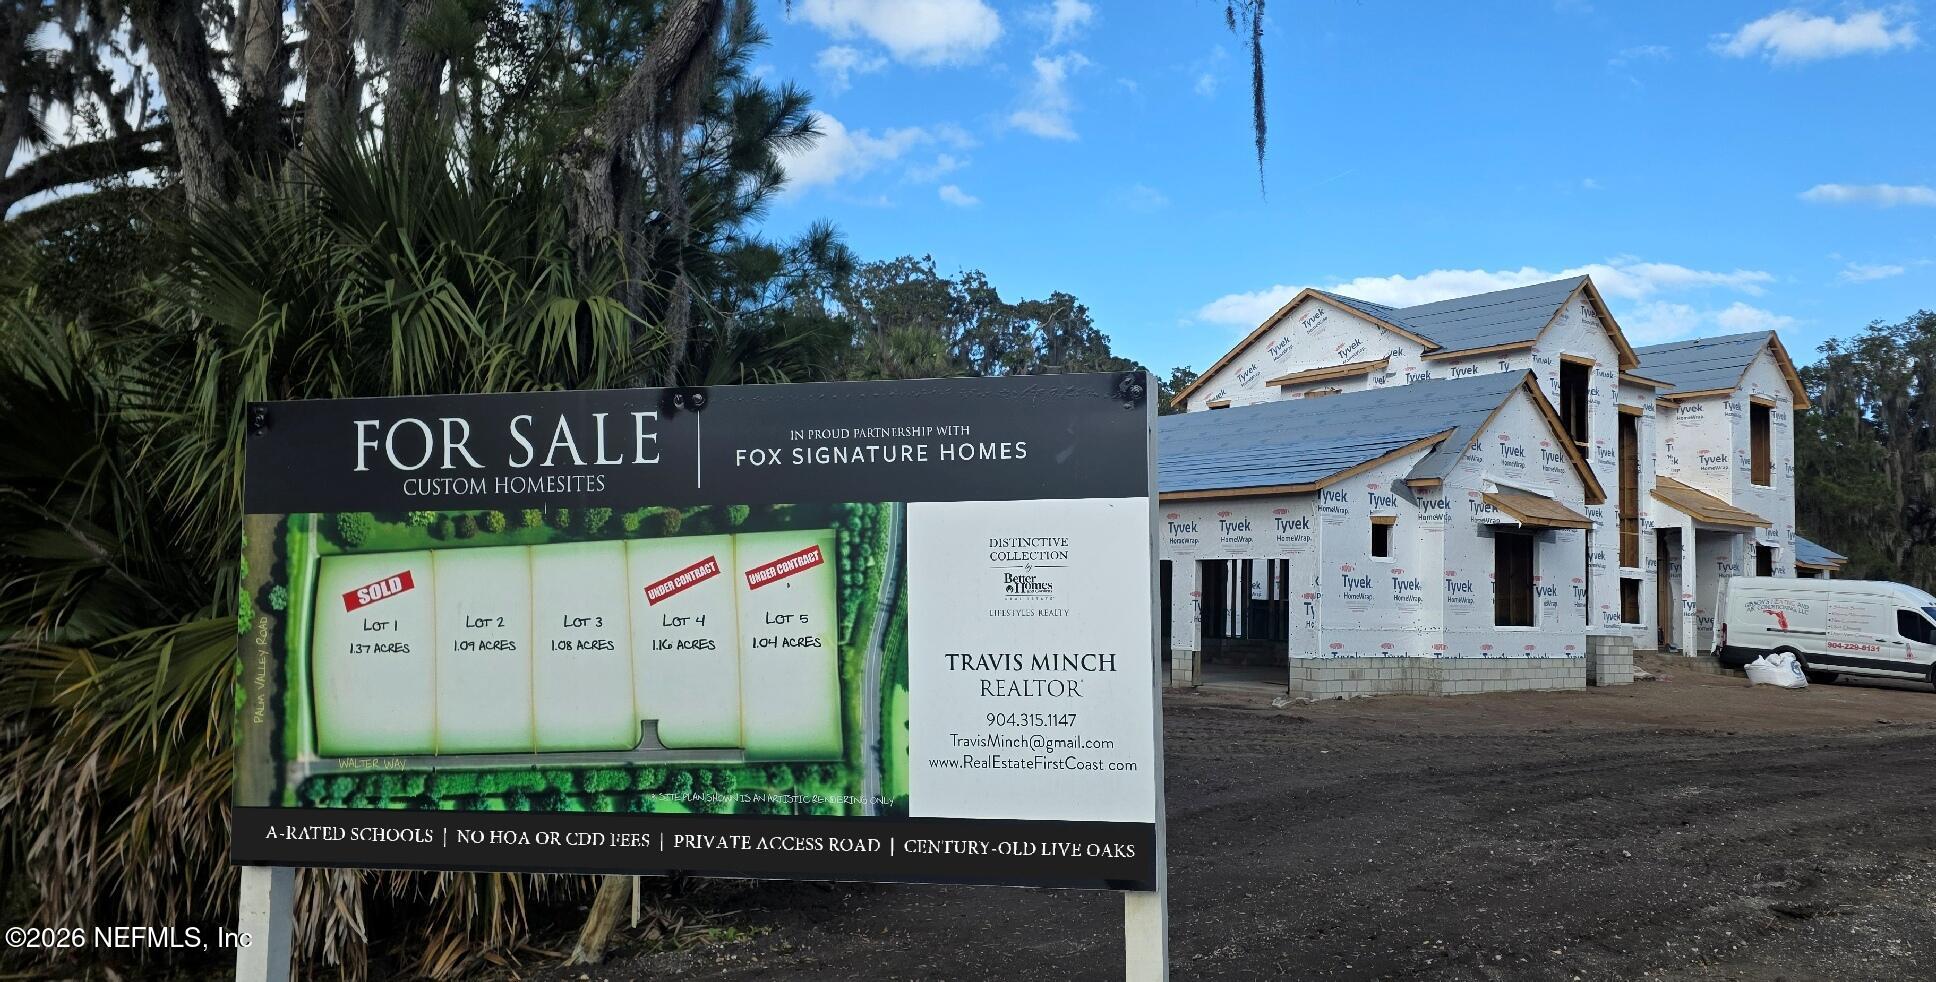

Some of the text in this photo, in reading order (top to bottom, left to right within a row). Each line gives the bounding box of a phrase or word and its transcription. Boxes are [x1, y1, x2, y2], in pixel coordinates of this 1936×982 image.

[1302, 308, 1325, 329] Tyvek
[1581, 306, 1598, 318] Tyve
[1268, 336, 1290, 357] Tyvek
[1338, 338, 1361, 359] Tyvek
[1237, 363, 1258, 383] Tyvek
[1406, 370, 1431, 384] Tyvek
[1451, 364, 1478, 378] Tyvek
[790, 425, 970, 440] IN PROUD PARTNERSHIP WITH
[353, 411, 660, 472] FOR SALE
[736, 441, 1027, 467] FOX SIGNATURE HOMES
[1500, 442, 1525, 458] Tyvek
[1540, 448, 1565, 464] Tyvek
[1597, 446, 1615, 458] Tyvek
[1699, 454, 1728, 466] Tyvek
[403, 474, 605, 496] CUSTOM HOMESITES
[1368, 492, 1397, 509] Tyvek
[1417, 496, 1450, 513] Tyvek
[1585, 507, 1603, 519] Tyvek
[1168, 520, 1198, 536] Tyvek
[1219, 518, 1250, 535] Tyvek
[1274, 516, 1310, 532] Tyvek
[989, 537, 1069, 548] DISTINCTIVE
[989, 550, 1069, 561] COLLECTION
[1589, 551, 1605, 562] yvek
[748, 550, 819, 585] UNDER CONTRACT
[1717, 562, 1739, 572] Tyvek
[647, 561, 717, 600] UNDER CONTRACT
[1003, 572, 1037, 584] Better
[1342, 574, 1372, 591] Tyvek
[1392, 577, 1420, 594] Tyvek
[356, 576, 402, 605] SOLD
[1014, 581, 1053, 594] Homes
[1446, 578, 1473, 594] Tyvek
[1573, 586, 1586, 600] Tyv
[799, 614, 809, 624] 5
[989, 608, 1070, 617] LIFESTYLES REALTY
[1603, 612, 1620, 623] Tyvek
[394, 619, 398, 631] 1
[496, 616, 505, 628] 2
[595, 616, 603, 628] 3
[695, 614, 706, 627] 4
[350, 642, 410, 654] 1.37 ACRES
[453, 639, 516, 652] 1.09 ACRES
[551, 639, 615, 651] 1.08 ACRES
[652, 638, 716, 651] 1.16 ACRES
[752, 636, 822, 648] 1.04 ACRES
[253, 616, 269, 724] PALM VALLEY ROAD
[945, 653, 1117, 672] TRAVIS MINCH
[980, 679, 1084, 698] REALTOR
[986, 712, 1077, 727] 904.315.1147
[949, 733, 1114, 753] TravisMinch@gmail.com
[338, 758, 407, 771] WALTER WAY
[928, 755, 1138, 771] www.RealEstateFirstCoastcom
[682, 793, 705, 802] PLAN
[706, 792, 739, 802] SHOWN
[740, 794, 751, 803] IS
[752, 794, 766, 802] AN
[767, 794, 811, 804] ARTISTIC
[811, 794, 868, 805] RENDERING
[869, 795, 895, 807] ONLY
[265, 825, 434, 843] A-RATED SCHOOLS
[457, 829, 651, 848] NO HOA OR CDD FEES
[673, 833, 882, 853] PRIVATE ACCESS ROAD
[904, 839, 1136, 859] CENTURY-OLD LIVE OAKS
